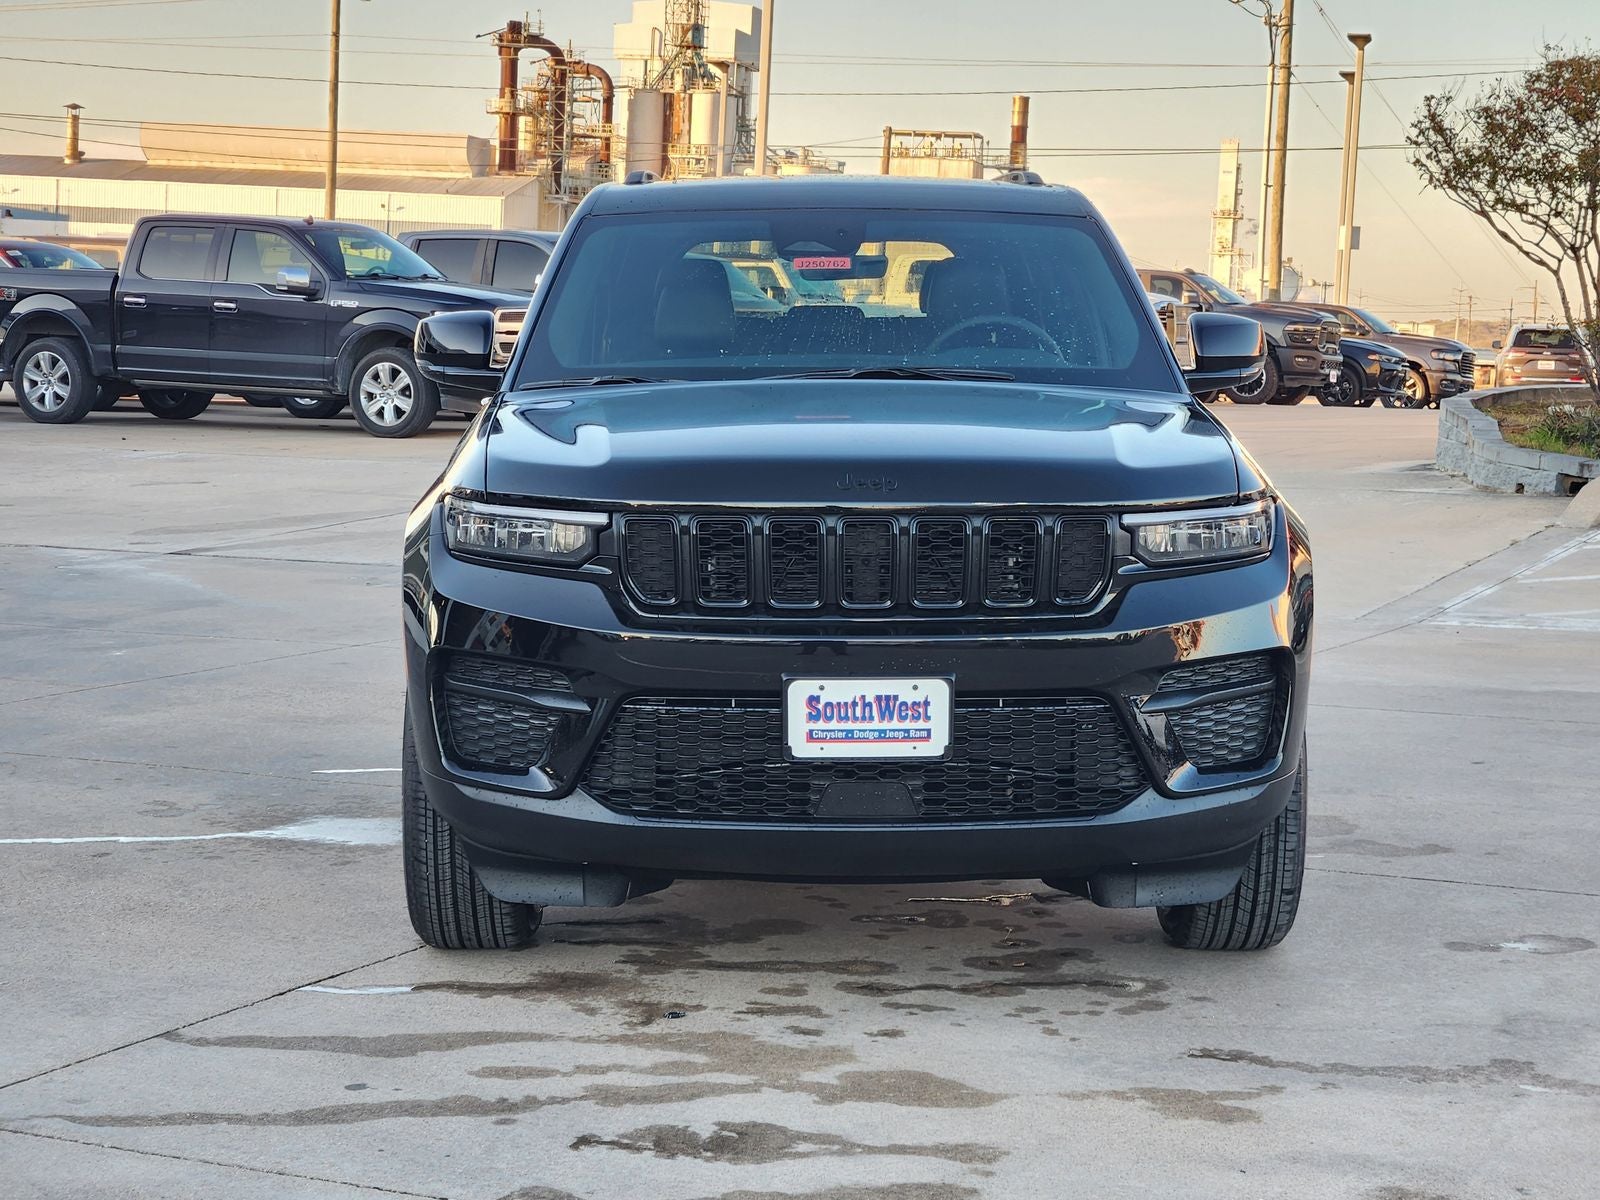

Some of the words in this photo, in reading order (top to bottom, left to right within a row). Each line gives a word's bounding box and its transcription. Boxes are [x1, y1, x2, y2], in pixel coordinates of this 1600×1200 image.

[797, 260, 847, 268] J250762
[0, 287, 17, 301] X4
[836, 472, 898, 494] Jeep
[805, 694, 931, 724] SouthWest
[812, 730, 847, 739] Chrysler
[853, 730, 879, 739] Dodge
[885, 729, 905, 739] Jeep
[909, 730, 928, 738] Ram
